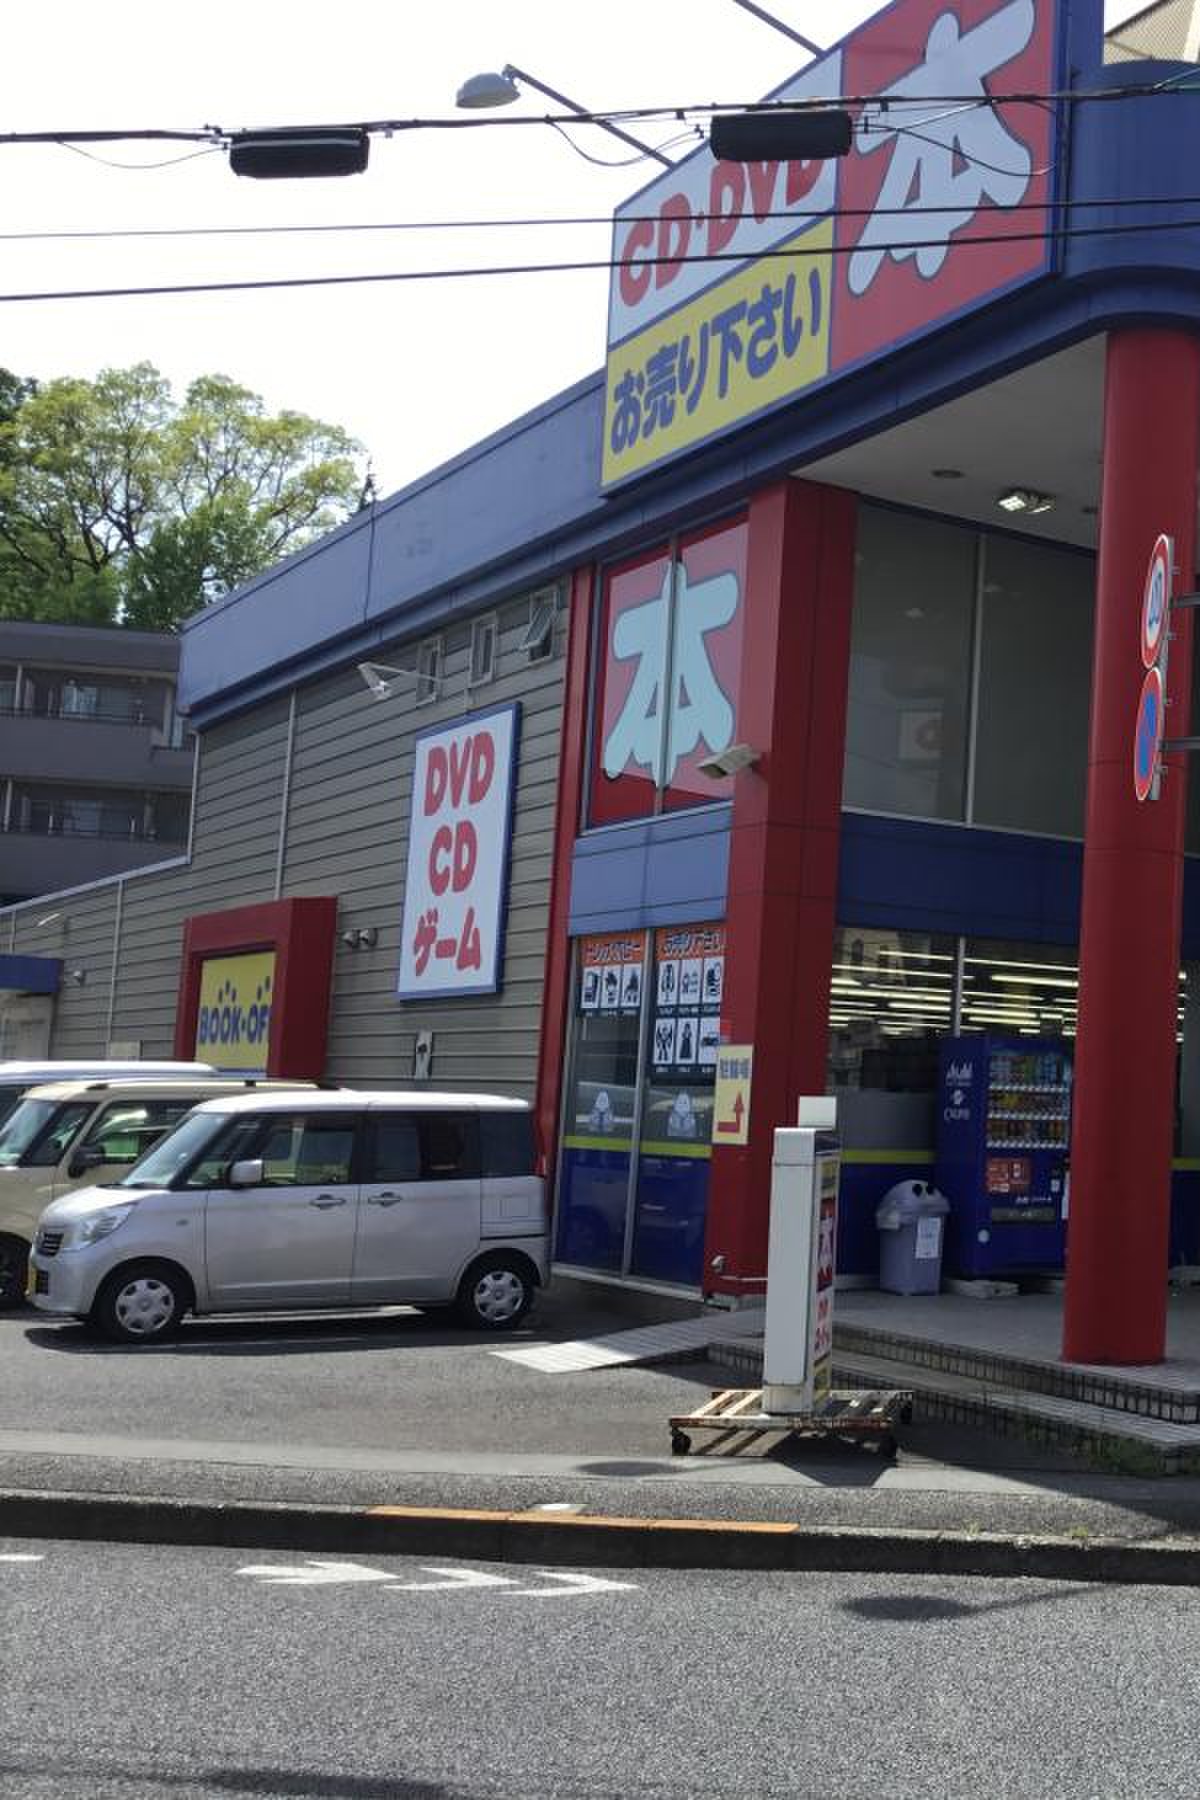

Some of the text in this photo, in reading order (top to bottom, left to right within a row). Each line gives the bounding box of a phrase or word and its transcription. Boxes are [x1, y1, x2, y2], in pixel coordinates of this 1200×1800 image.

[847, 0, 1034, 297] 本
[610, 267, 821, 455] お売り下さい
[603, 560, 740, 789] 本
[424, 732, 496, 816] DVD
[428, 820, 478, 897] CD
[413, 907, 482, 977] ゲーム
